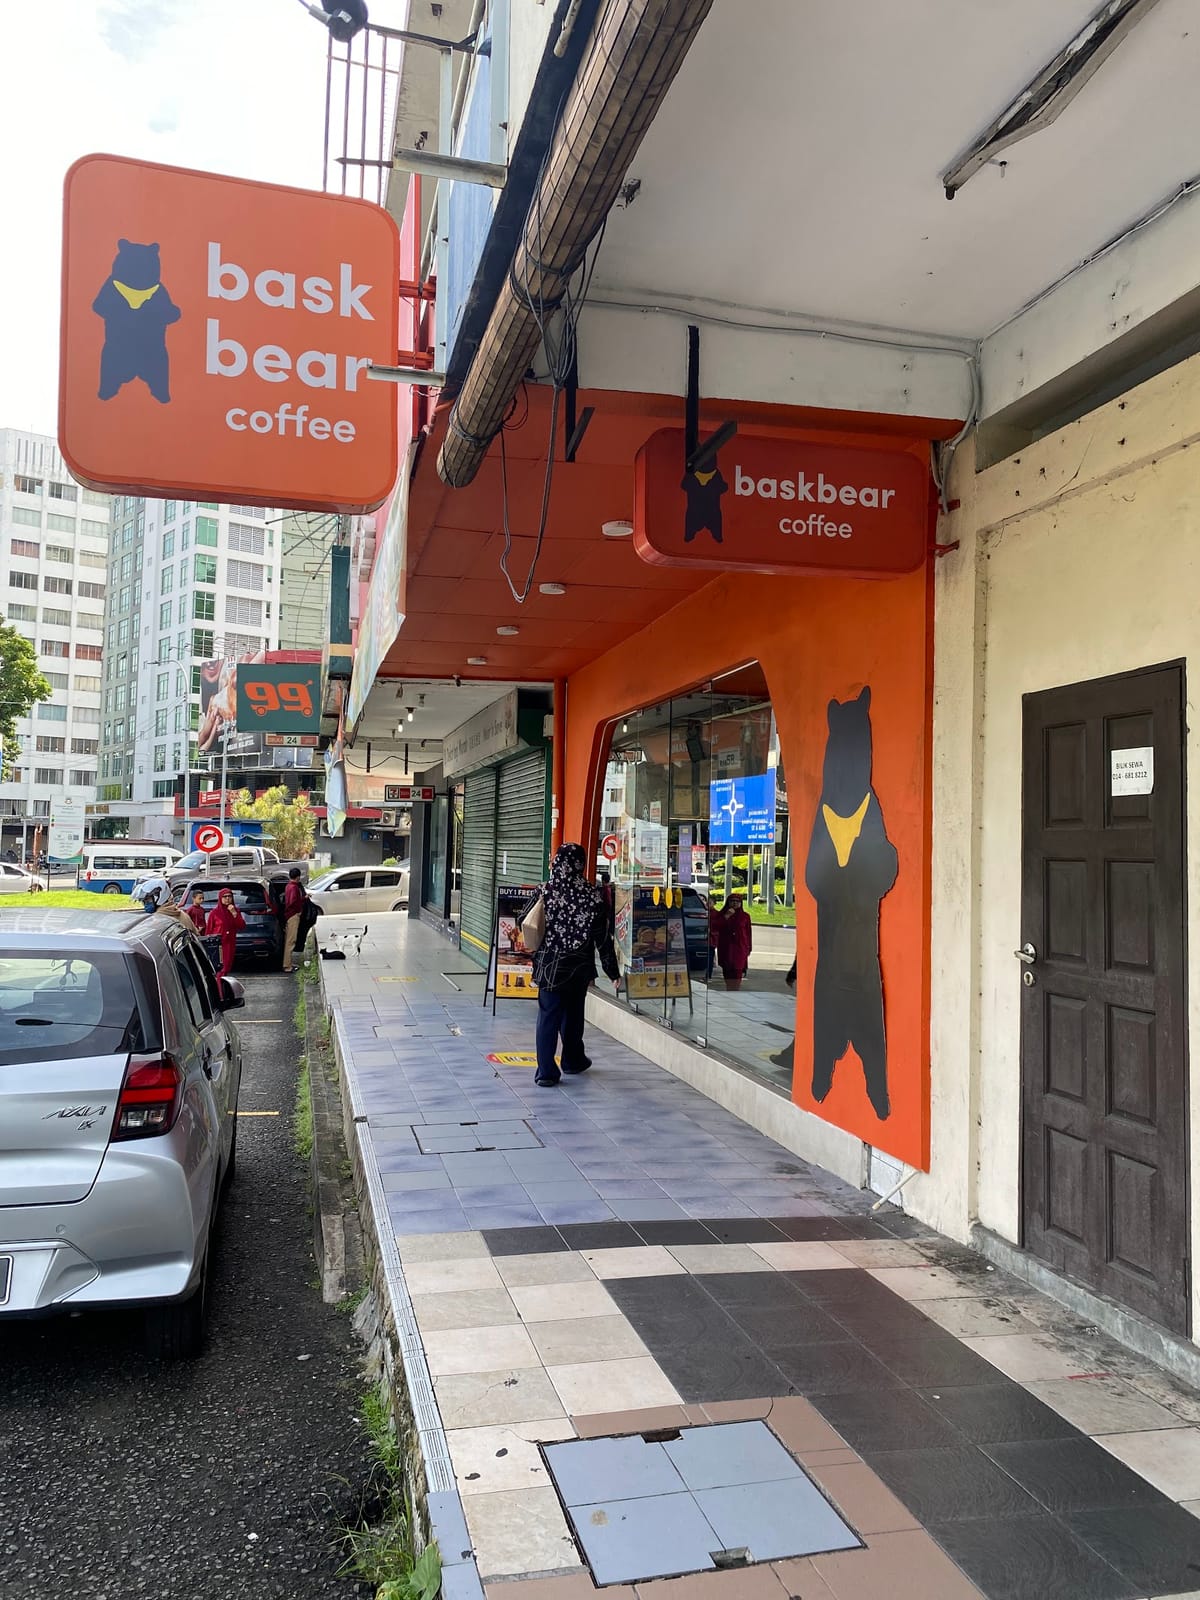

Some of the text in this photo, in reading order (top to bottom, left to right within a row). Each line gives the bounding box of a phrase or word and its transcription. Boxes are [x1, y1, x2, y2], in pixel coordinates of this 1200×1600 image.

[207, 241, 376, 321] bask
[206, 318, 373, 392] bear
[225, 403, 356, 443] coffee
[735, 465, 896, 509] baskbear
[779, 514, 853, 539] coffee
[244, 681, 313, 717] 99
[286, 736, 297, 744] 24
[1129, 761, 1143, 769] SEWA
